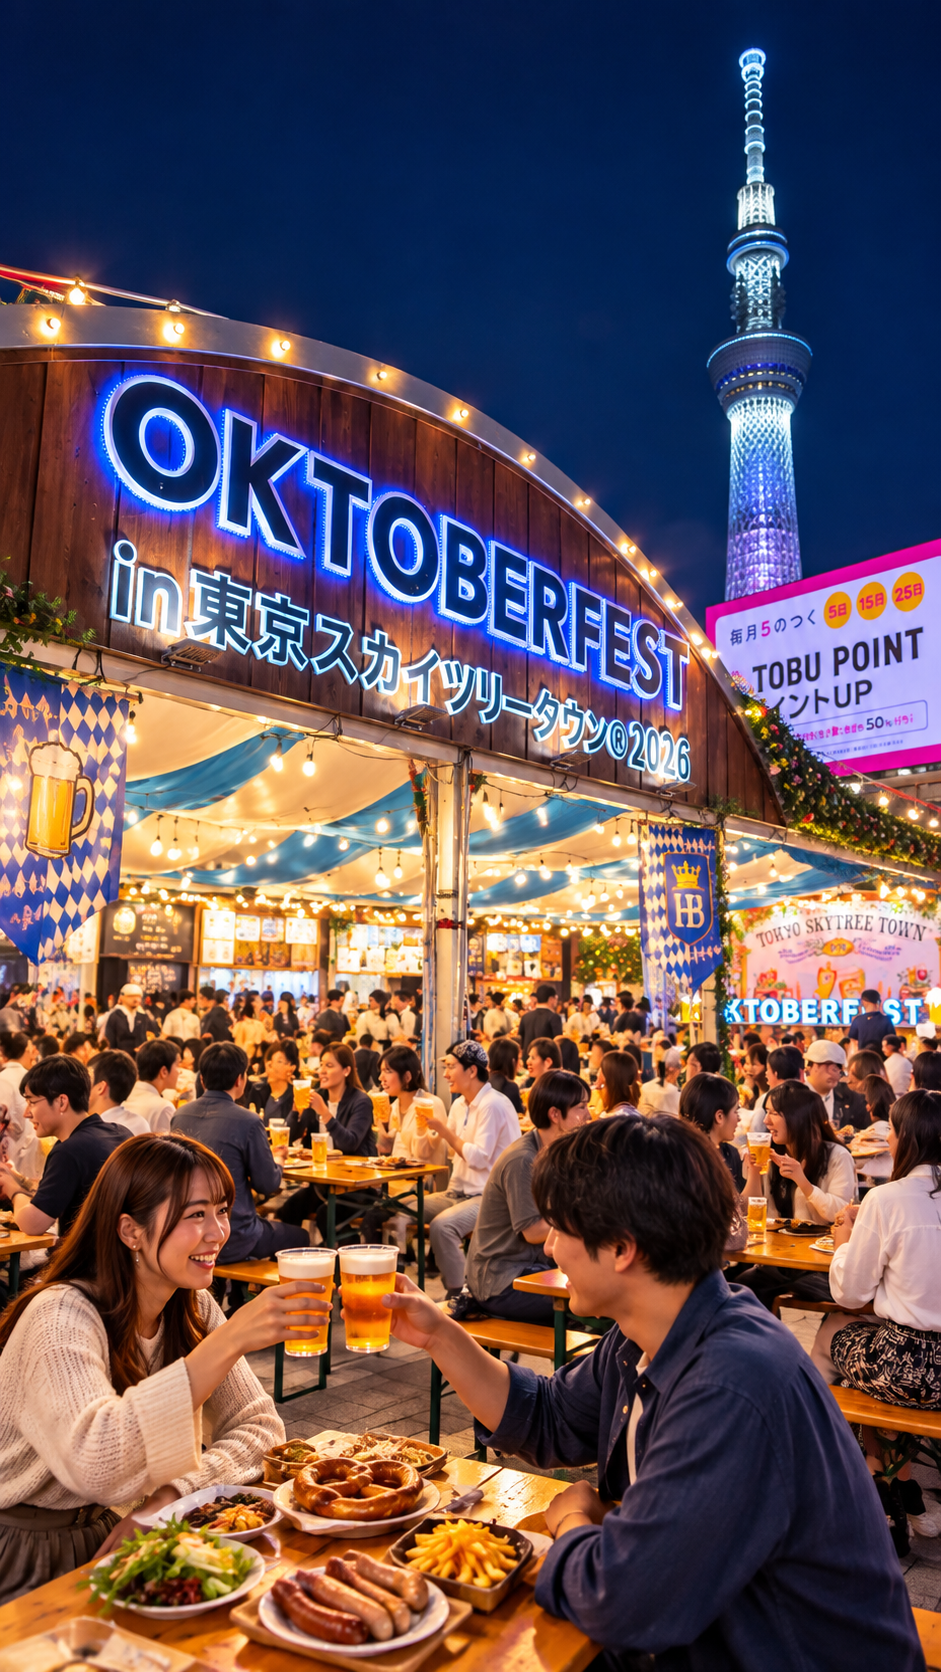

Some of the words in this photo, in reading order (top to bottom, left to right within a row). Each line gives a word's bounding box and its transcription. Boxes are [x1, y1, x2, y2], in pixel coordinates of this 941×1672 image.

[103, 375, 689, 711] OKTOBERFEST
[828, 602, 847, 620] 5日
[859, 592, 885, 611] 15日
[894, 582, 923, 602] 25日
[752, 651, 821, 693] TOBU
[834, 627, 924, 677] POINT
[805, 914, 873, 934] SKYTREE
[878, 916, 927, 942] TOWN
[724, 998, 924, 1026] KTOBERFST
